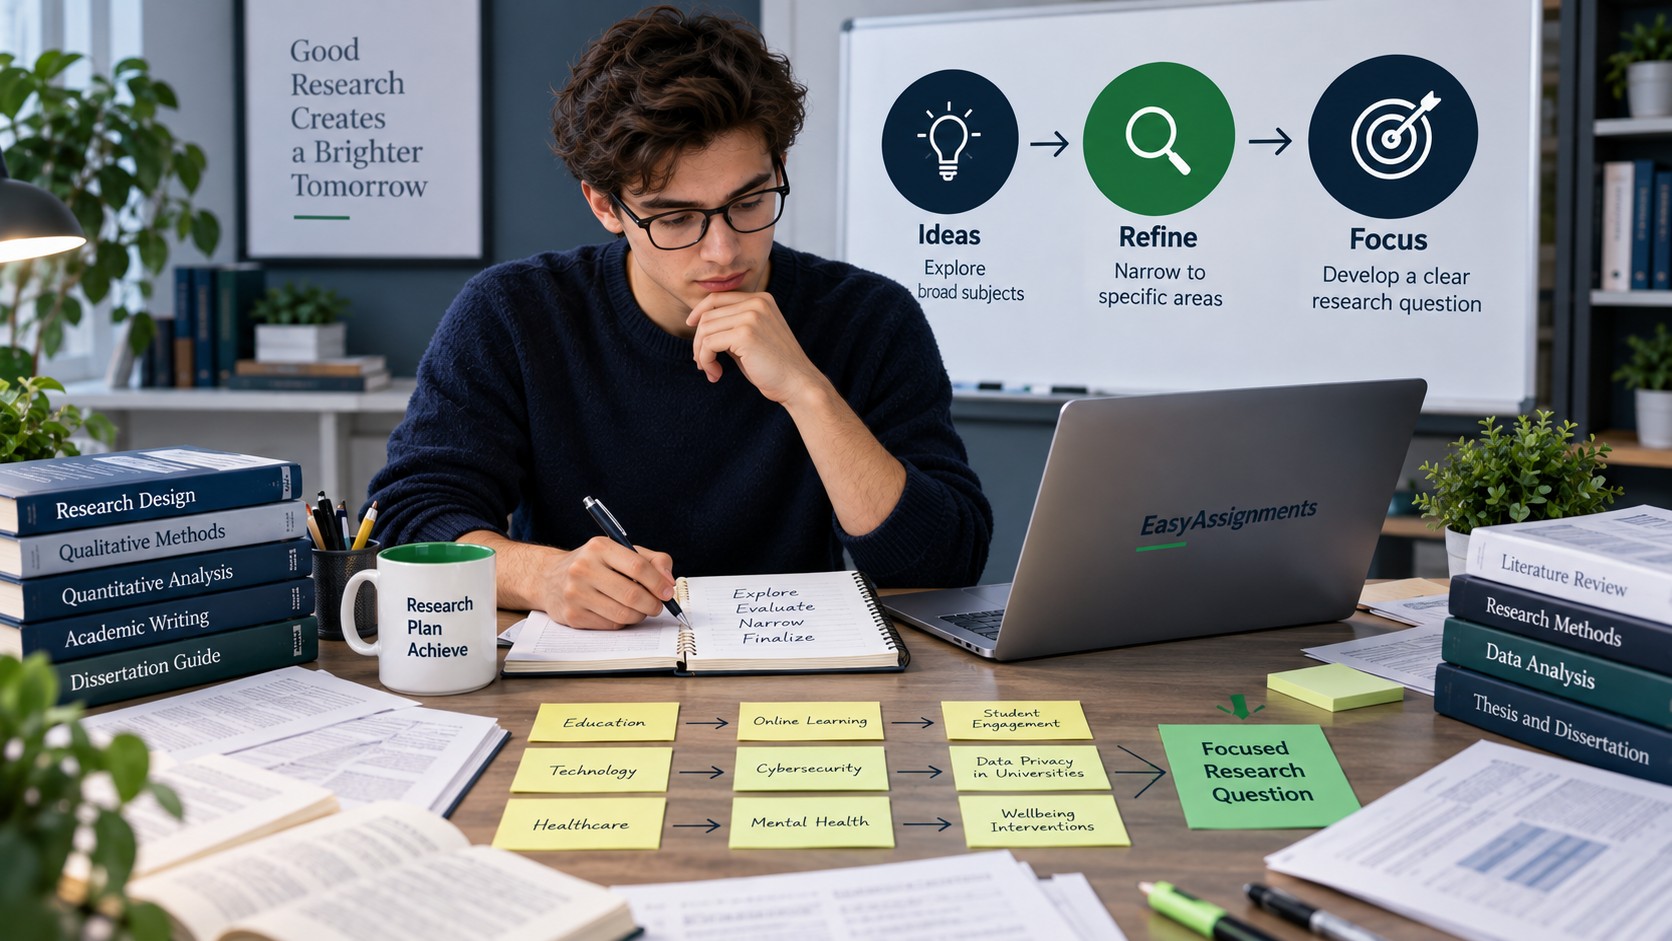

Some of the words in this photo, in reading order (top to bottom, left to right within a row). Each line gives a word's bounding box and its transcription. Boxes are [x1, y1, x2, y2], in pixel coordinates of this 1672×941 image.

[290, 37, 360, 63] Good
[291, 70, 405, 97] Research
[291, 105, 386, 131] Creates
[292, 144, 306, 164] a
[314, 138, 424, 170] Brighter
[291, 173, 428, 198] Tomorrow
[918, 223, 981, 246] Ideas
[1119, 225, 1198, 249] Refine
[1350, 227, 1428, 252] Focus
[924, 259, 986, 280] Explore
[1114, 263, 1182, 280] Narrow
[1187, 264, 1206, 281] to
[1323, 265, 1400, 288] Develop
[1408, 270, 1417, 284] a
[1424, 266, 1470, 285] clear
[918, 283, 957, 300] broad
[962, 283, 1025, 304] subjects
[1098, 288, 1168, 311] specific
[1173, 292, 1223, 307] areas
[1312, 292, 1393, 311] research
[1399, 293, 1482, 315] question
[56, 493, 134, 521] Research
[139, 488, 197, 512] Design
[1140, 498, 1318, 537] EasyAssignments
[58, 530, 150, 564] Qualitative
[155, 523, 226, 548] Methods
[1501, 553, 1570, 585] Literature
[1574, 571, 1628, 598] Review
[61, 576, 164, 607] Quantitative
[168, 564, 234, 588] Analysis
[732, 587, 799, 602] Explore
[407, 596, 474, 614] Research
[736, 602, 816, 615] Evaluate
[64, 619, 145, 649] Academic
[149, 608, 210, 634] Writing
[407, 619, 443, 637] Plan
[738, 617, 805, 629] Narrow
[1486, 597, 1550, 628] Research
[1553, 614, 1622, 648] Methods
[742, 632, 816, 645] Finalize
[407, 640, 469, 658] Achieve
[70, 659, 170, 693] Dissertation
[174, 648, 221, 670] Guide
[1486, 643, 1522, 669] Data
[1526, 649, 1596, 690] Analysis
[563, 717, 647, 729] Education
[753, 714, 800, 727] Online
[806, 714, 868, 730] Learning
[983, 708, 1041, 719] Student
[971, 718, 1061, 731] Engagement
[1473, 693, 1518, 722] Thesis
[1522, 710, 1551, 732] and
[1554, 717, 1650, 766] Dissertation
[1201, 741, 1290, 757] Focused
[549, 764, 638, 780] Technology
[756, 761, 863, 777] Cybersecurity
[976, 755, 1013, 768] Data
[1019, 755, 1075, 770] Privacy
[1204, 763, 1306, 780] Research
[973, 768, 987, 778] in
[995, 767, 1085, 779] Universities
[1211, 786, 1314, 804] Question
[751, 815, 810, 829] Mental
[815, 814, 871, 829] Health
[1000, 807, 1076, 823] Wellbeing
[532, 818, 630, 832] Healthcare
[990, 821, 1095, 833] Interventions
